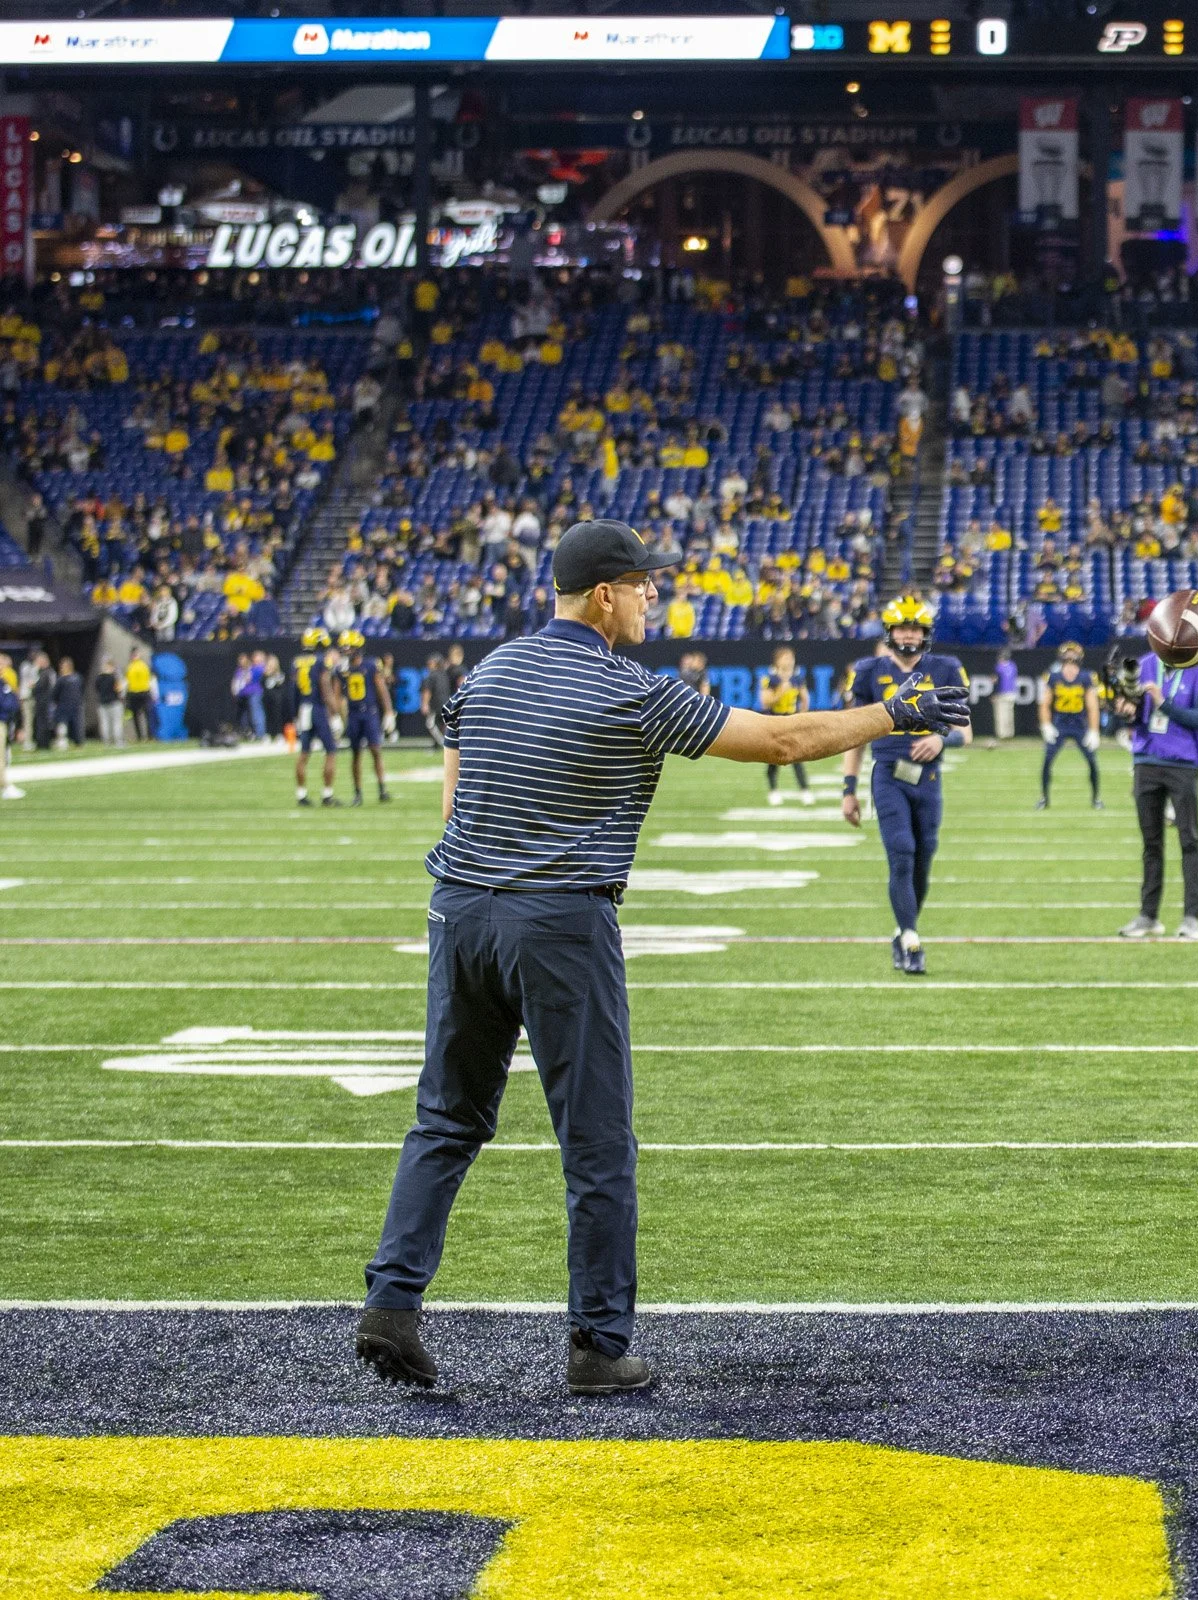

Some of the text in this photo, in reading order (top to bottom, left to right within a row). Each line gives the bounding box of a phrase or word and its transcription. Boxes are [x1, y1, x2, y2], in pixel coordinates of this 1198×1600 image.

[330, 28, 431, 51] Marathon
[868, 20, 911, 54] M
[977, 19, 1008, 55] 0
[193, 126, 417, 148] LUCAS OIL STADIU
[671, 126, 918, 145] LUCAS OIL STADIUM
[206, 223, 357, 268] LUCAS
